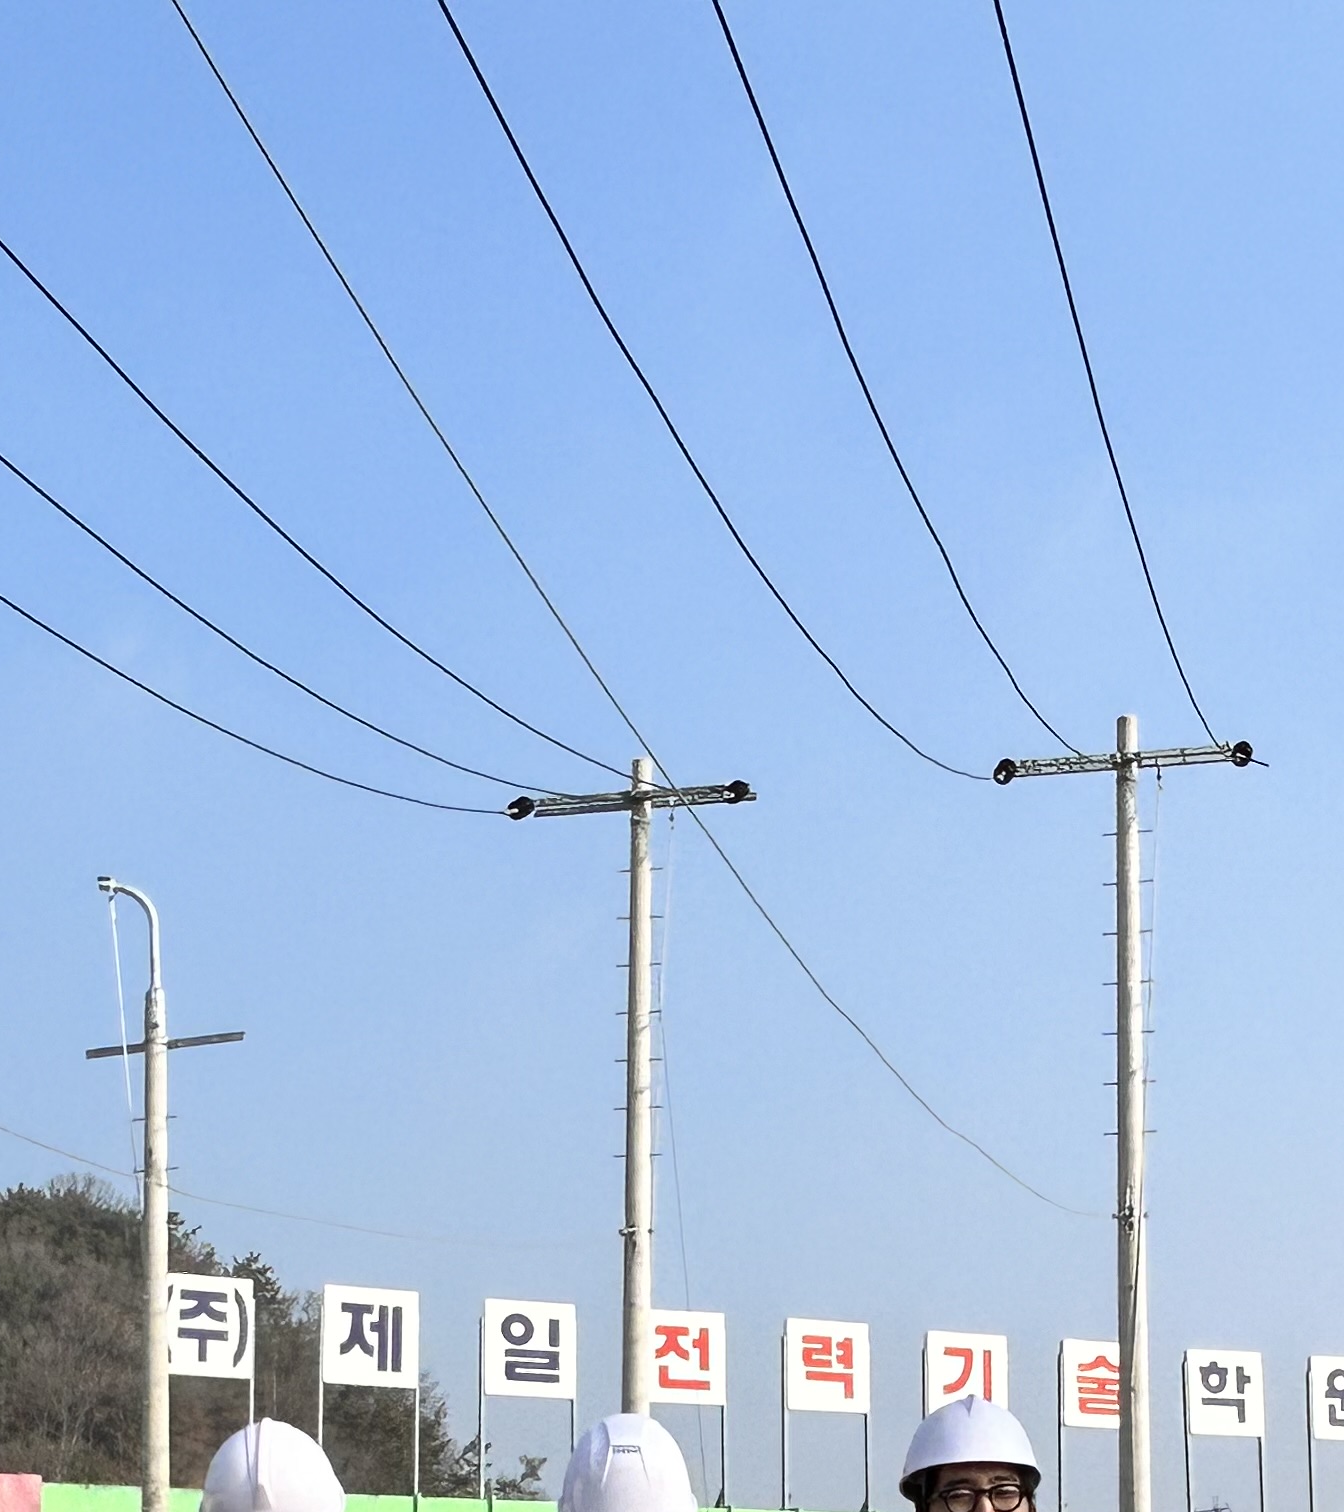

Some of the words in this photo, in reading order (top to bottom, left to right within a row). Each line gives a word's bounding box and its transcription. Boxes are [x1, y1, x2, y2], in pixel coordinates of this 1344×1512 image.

[339, 1302, 403, 1373] 제
[500, 1313, 560, 1384] 일
[655, 1325, 710, 1391] 전
[802, 1335, 854, 1398] 력
[943, 1347, 992, 1403] 기
[1077, 1355, 1120, 1415] 술
[1199, 1361, 1252, 1424] 학
